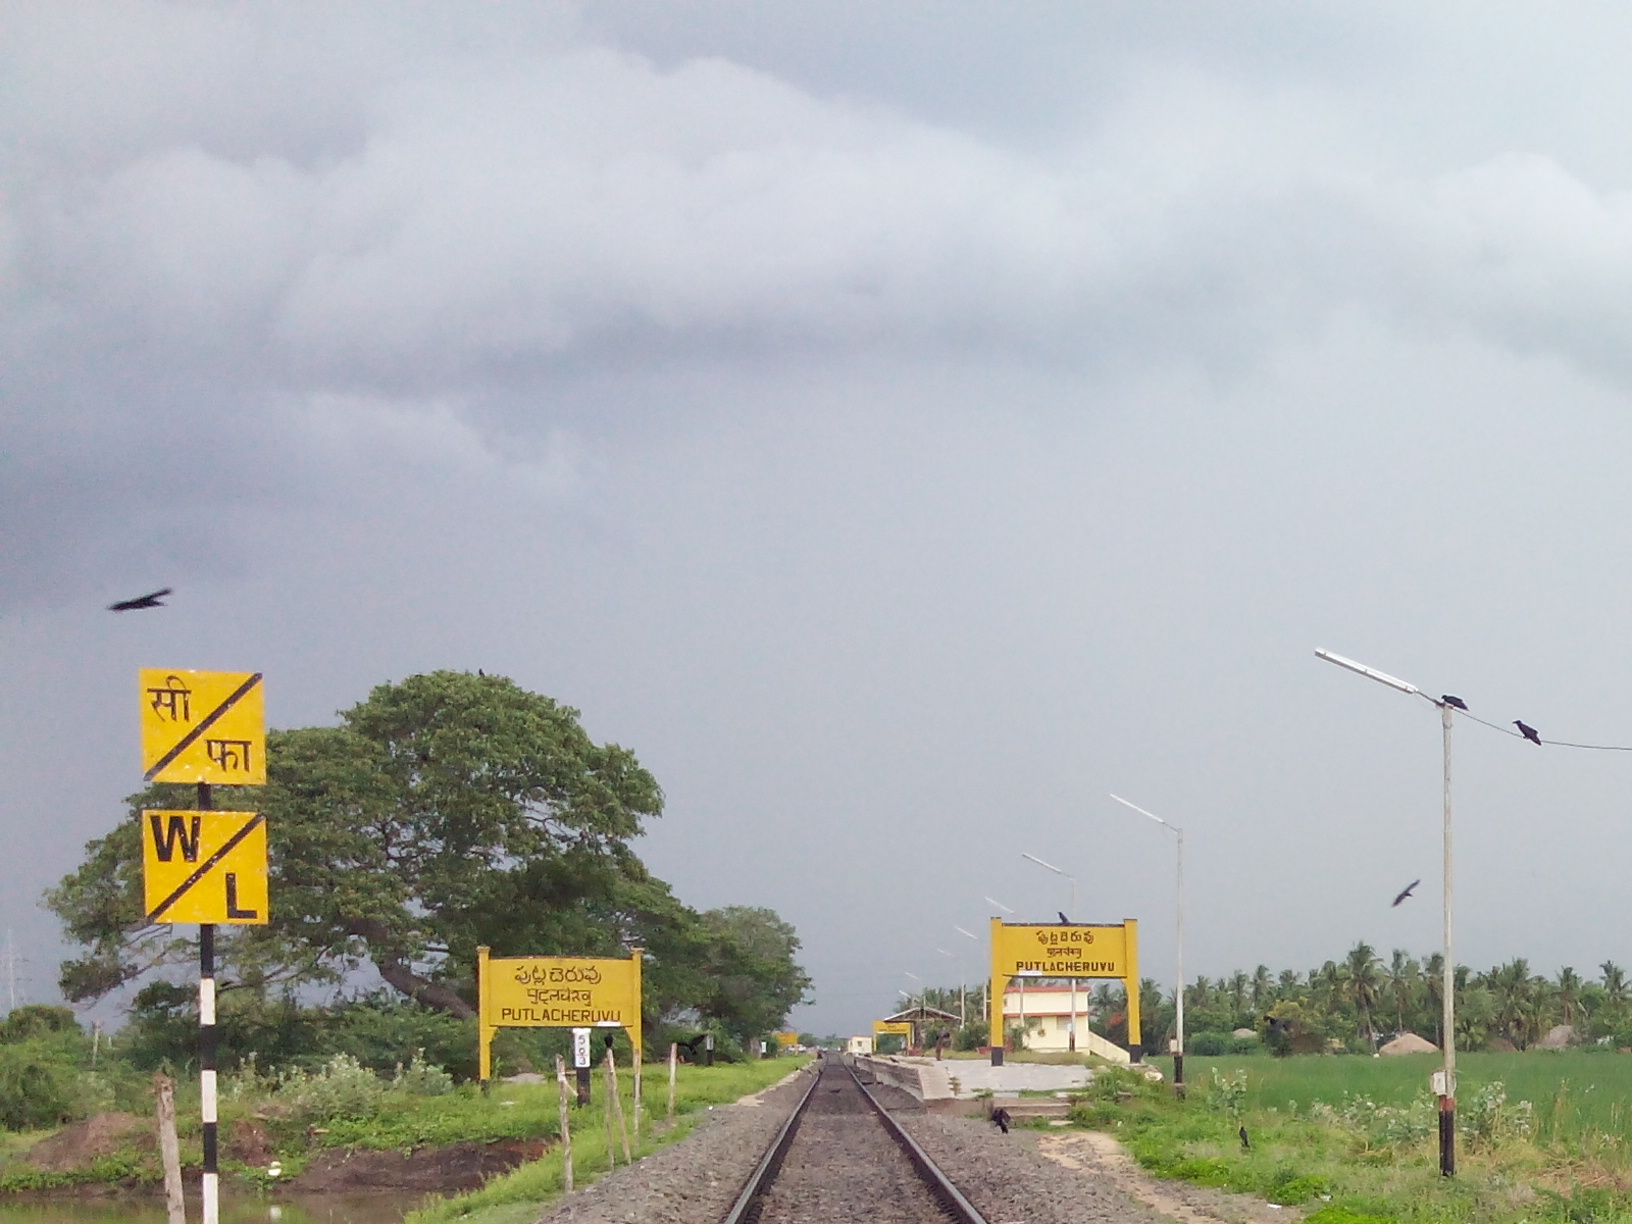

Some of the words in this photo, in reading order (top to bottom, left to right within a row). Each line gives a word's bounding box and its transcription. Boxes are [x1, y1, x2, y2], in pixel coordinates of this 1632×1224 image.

[147, 675, 192, 722] सी
[150, 815, 201, 863] W
[225, 873, 257, 919] L
[1016, 961, 1115, 972] PUTLACHERUVU
[502, 1008, 621, 1022] PUTLACHERUVU
